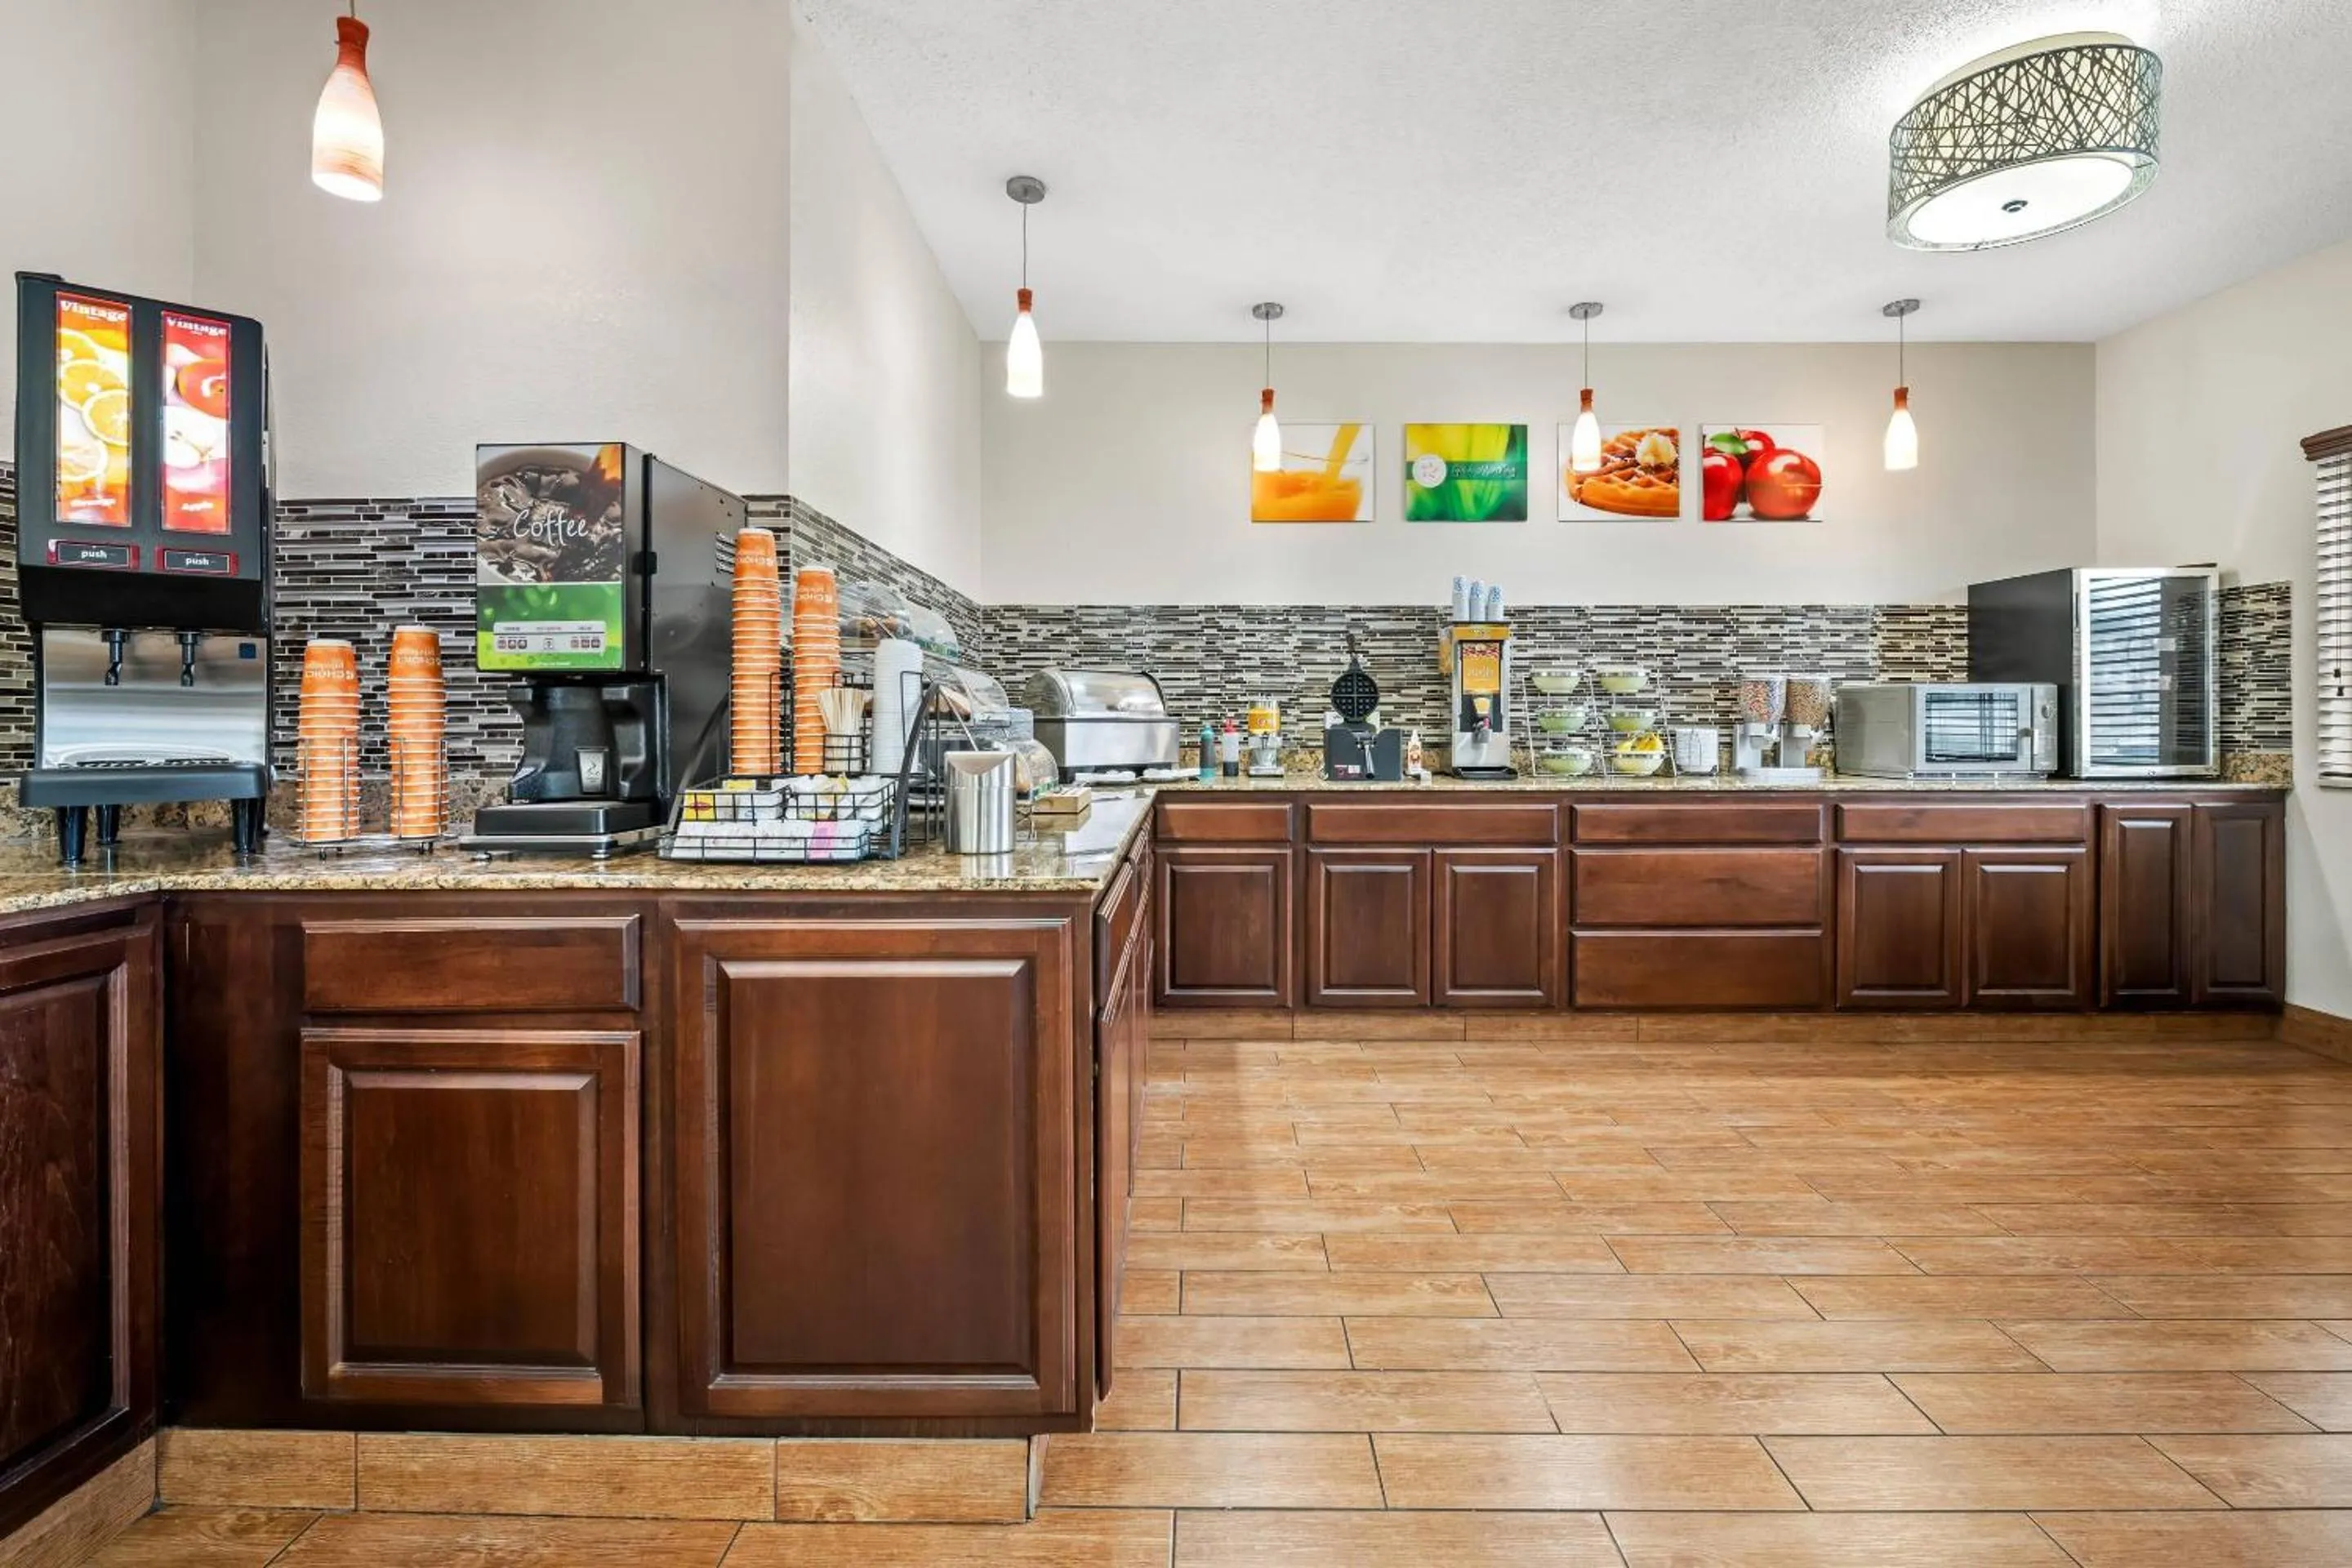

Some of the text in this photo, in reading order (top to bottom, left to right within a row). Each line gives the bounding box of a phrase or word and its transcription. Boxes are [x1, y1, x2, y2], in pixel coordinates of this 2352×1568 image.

[60, 300, 127, 322] Vintage
[167, 317, 227, 336] Vintage
[513, 509, 589, 546] Coffee
[81, 550, 107, 559] push
[185, 557, 210, 566] push
